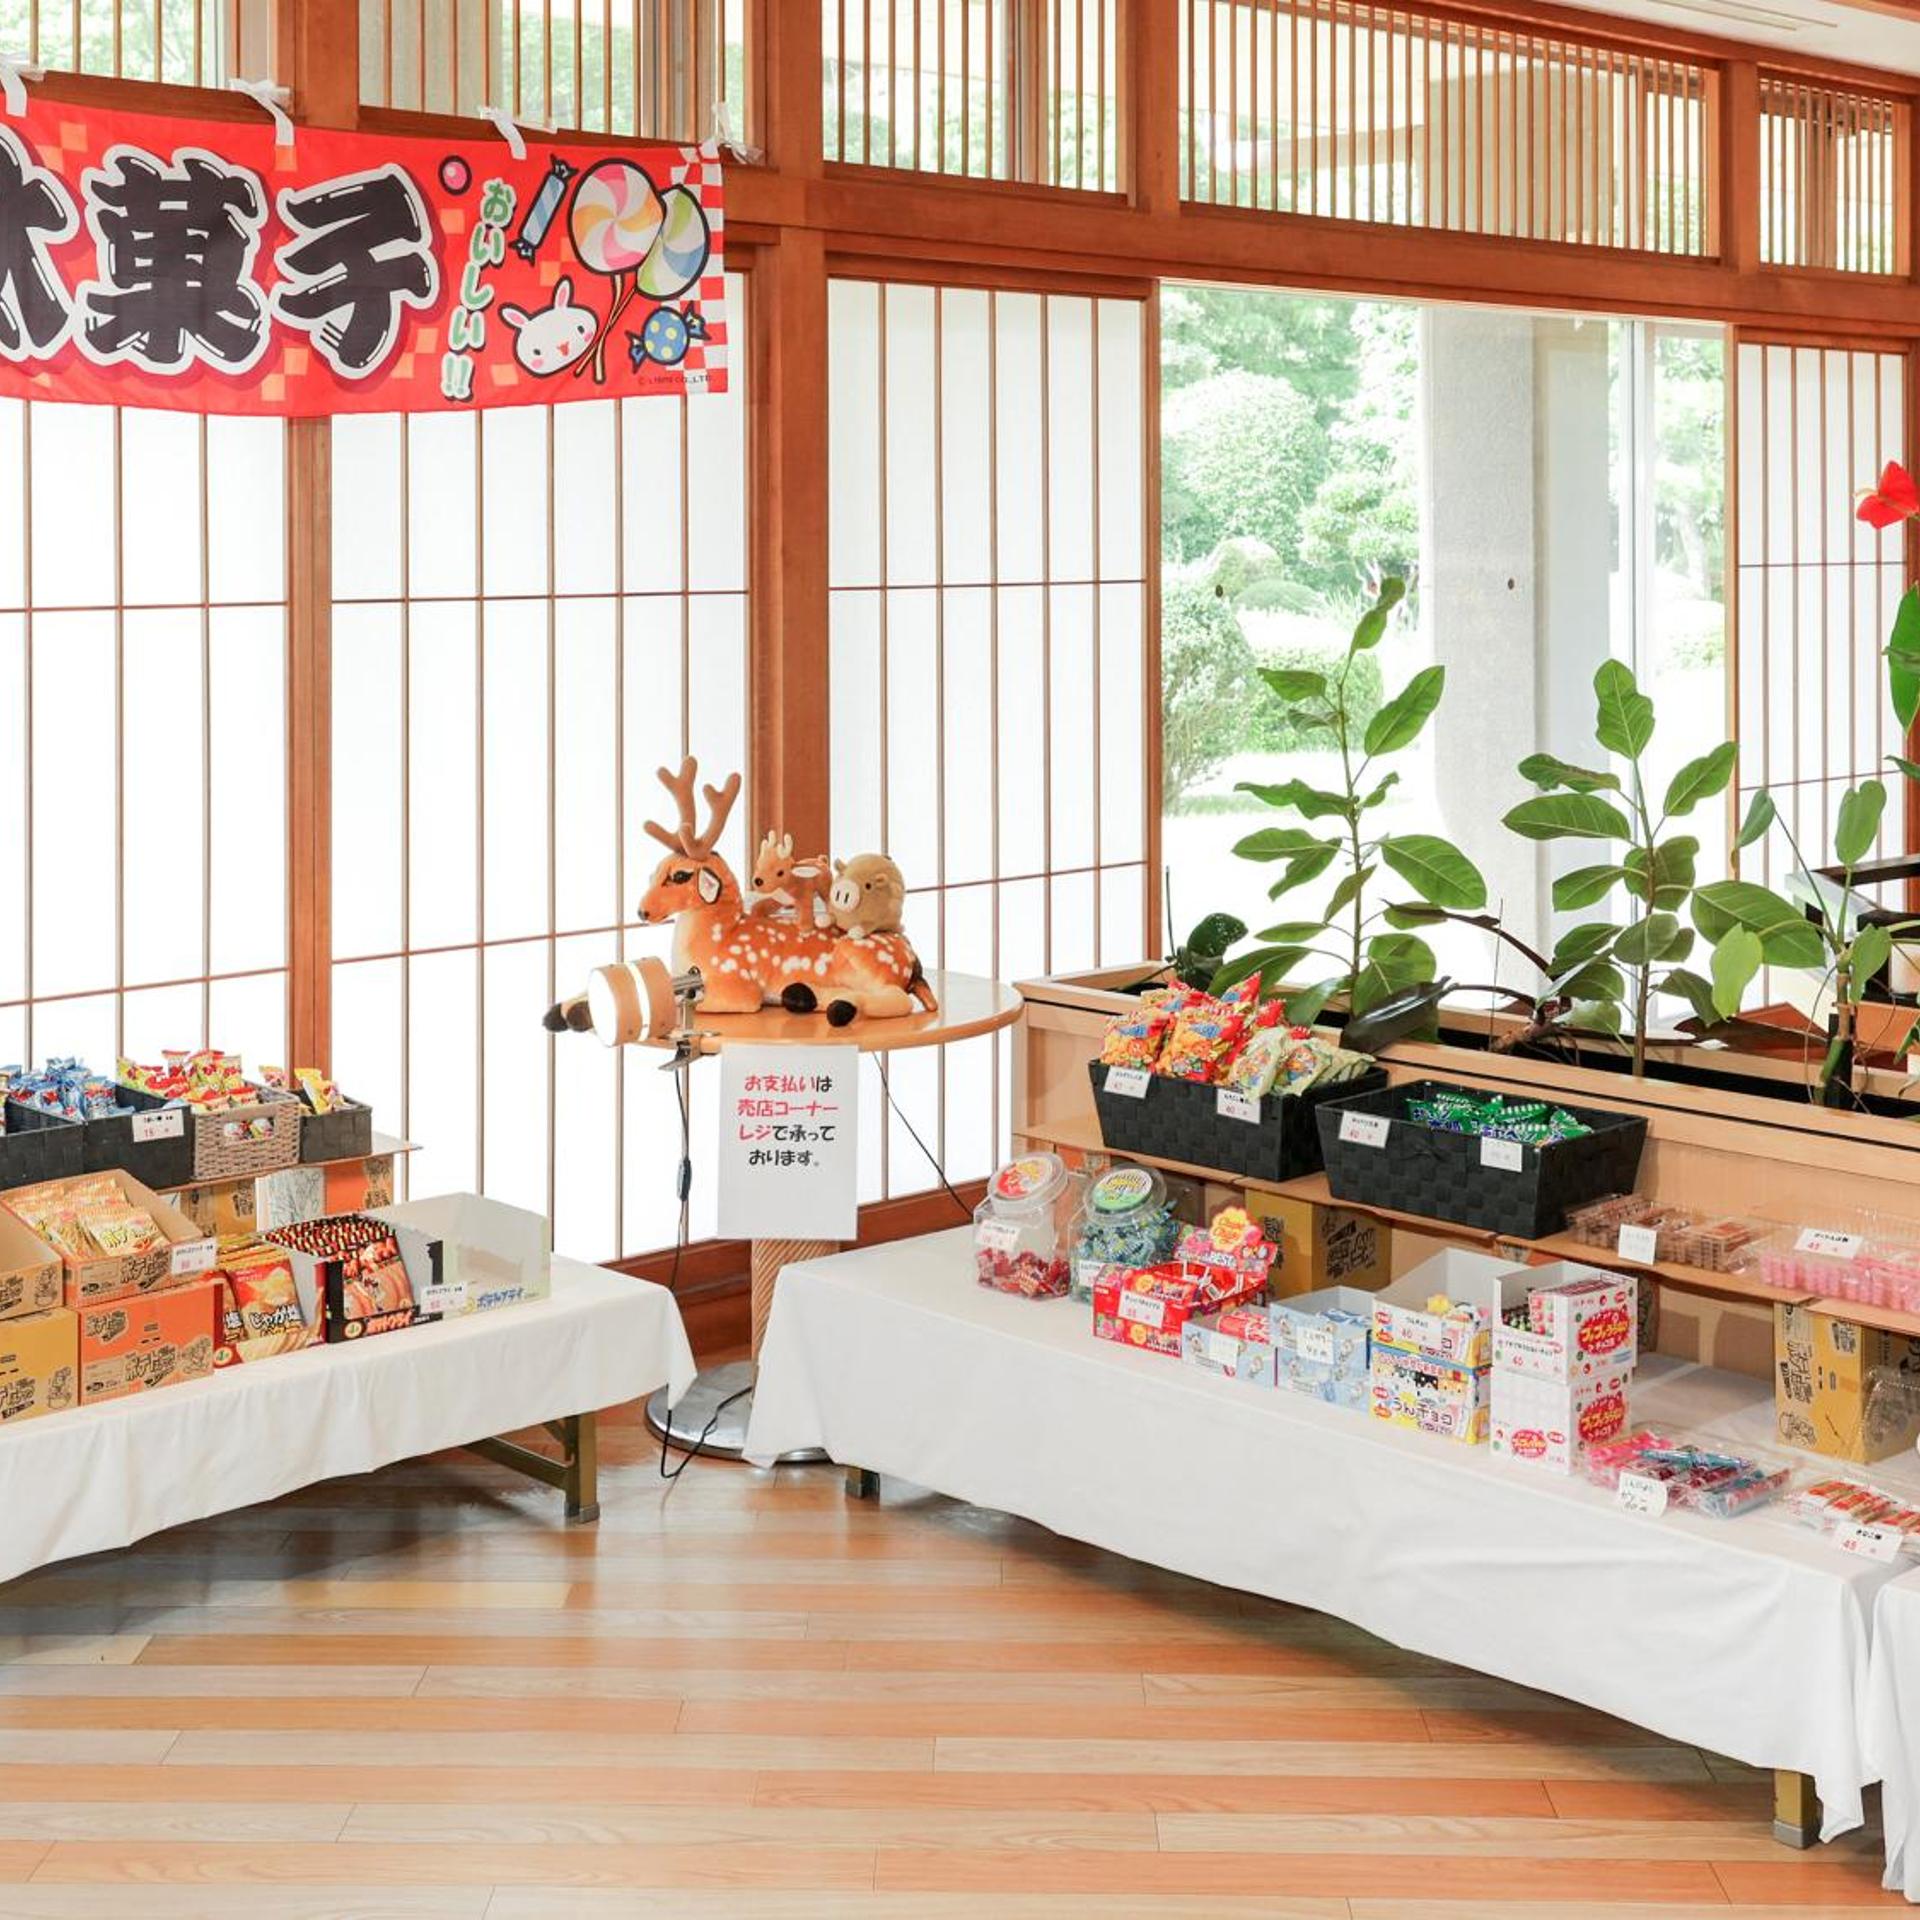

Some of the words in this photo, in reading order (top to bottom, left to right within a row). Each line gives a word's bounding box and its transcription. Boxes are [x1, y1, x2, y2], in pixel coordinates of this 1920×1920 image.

[744, 1075, 833, 1093] お支払いは
[737, 1099, 839, 1117] 売店コーナー
[739, 1124, 836, 1142] レジで承って
[749, 1149, 820, 1167] おります。
[1393, 1396, 1452, 1427] うんチョコ
